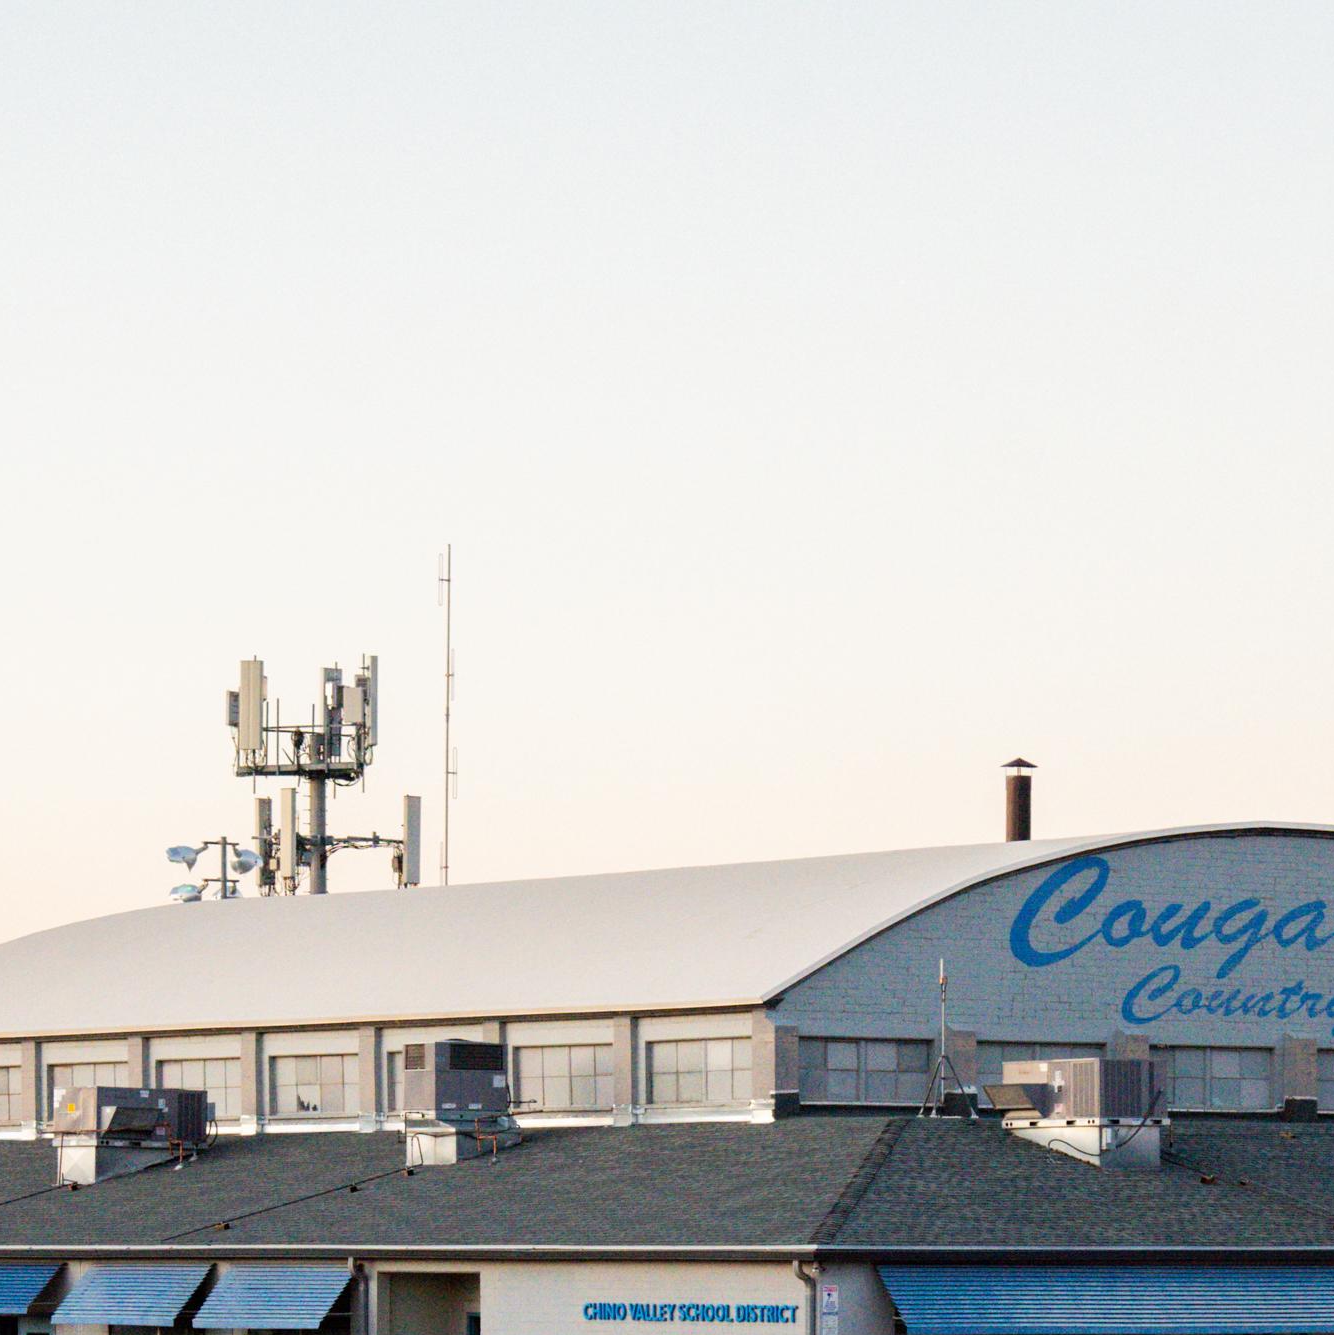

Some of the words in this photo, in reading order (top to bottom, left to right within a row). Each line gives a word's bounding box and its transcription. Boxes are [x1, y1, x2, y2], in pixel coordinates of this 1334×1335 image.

[583, 1302, 627, 1320] CHINO
[629, 1303, 676, 1321] VALLEY
[678, 1303, 734, 1322] SCHOOL
[734, 1304, 798, 1323] DISTRICT
